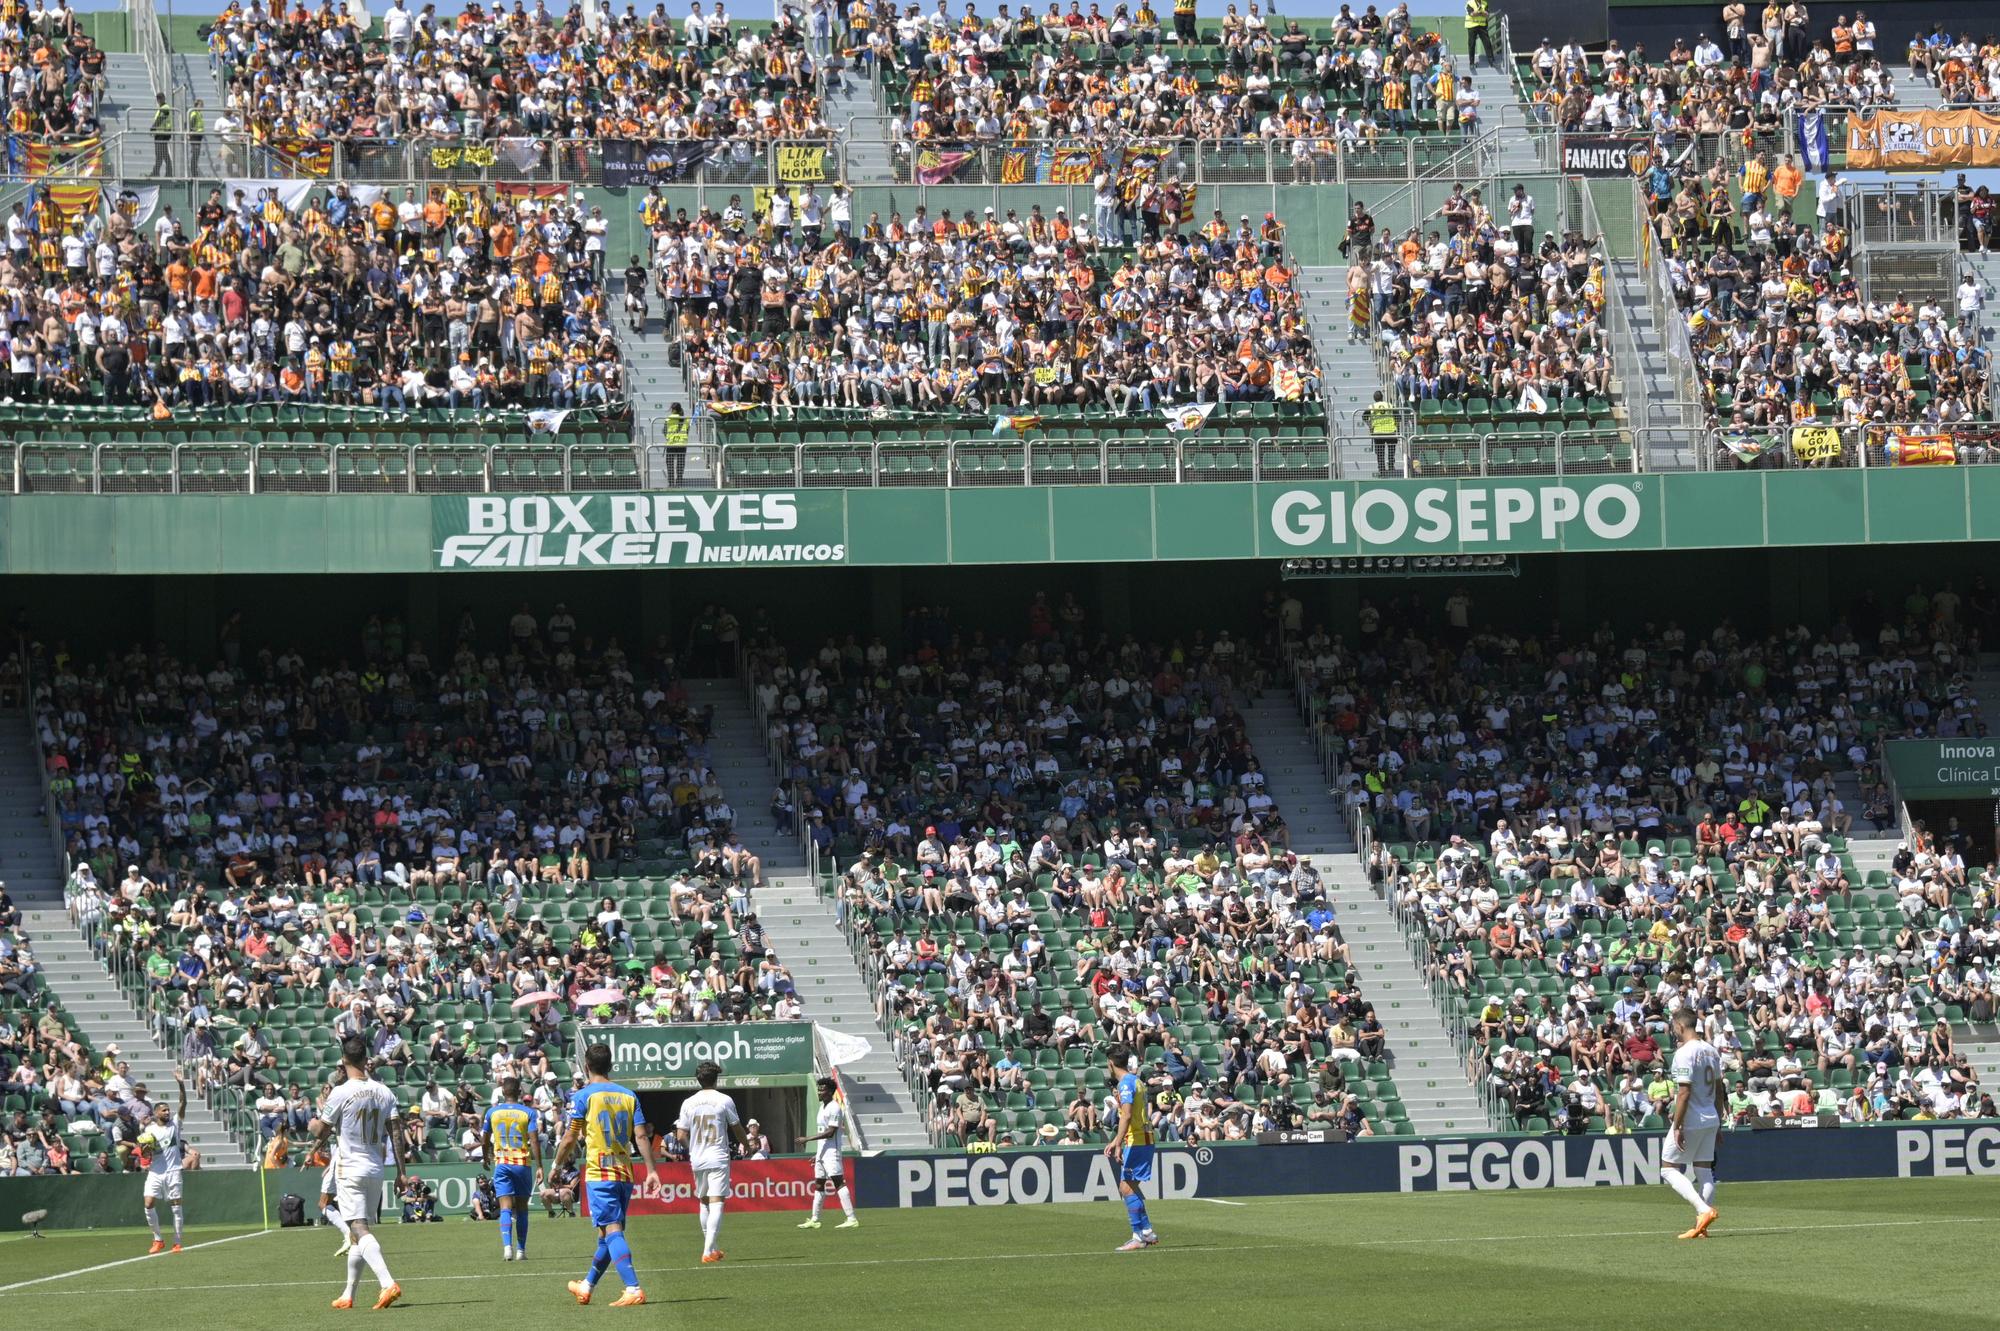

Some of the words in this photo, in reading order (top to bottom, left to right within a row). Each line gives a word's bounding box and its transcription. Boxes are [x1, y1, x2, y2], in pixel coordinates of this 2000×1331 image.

[787, 148, 814, 159] LIM
[1565, 148, 1627, 170] FANATICS
[781, 168, 822, 178] HOME
[793, 160, 808, 168] GO
[1797, 443, 1839, 458] HOME
[1807, 437, 1824, 446] GO
[468, 496, 594, 534] BOX
[610, 493, 798, 533] REYES
[432, 532, 703, 567] FALKEN
[703, 544, 845, 562] NEUMATICOS
[1940, 743, 1995, 758] Innova
[1937, 767, 1989, 782] Clínica
[785, 1035, 806, 1043] digital
[588, 1030, 751, 1071] lmagraph
[669, 1080, 702, 1088] SALIDA
[1704, 1064, 1715, 1098] 9
[355, 1107, 380, 1145] 11
[496, 1121, 523, 1149] 16
[693, 1114, 717, 1146] 15
[1399, 1137, 1694, 1193] PEGOLAN
